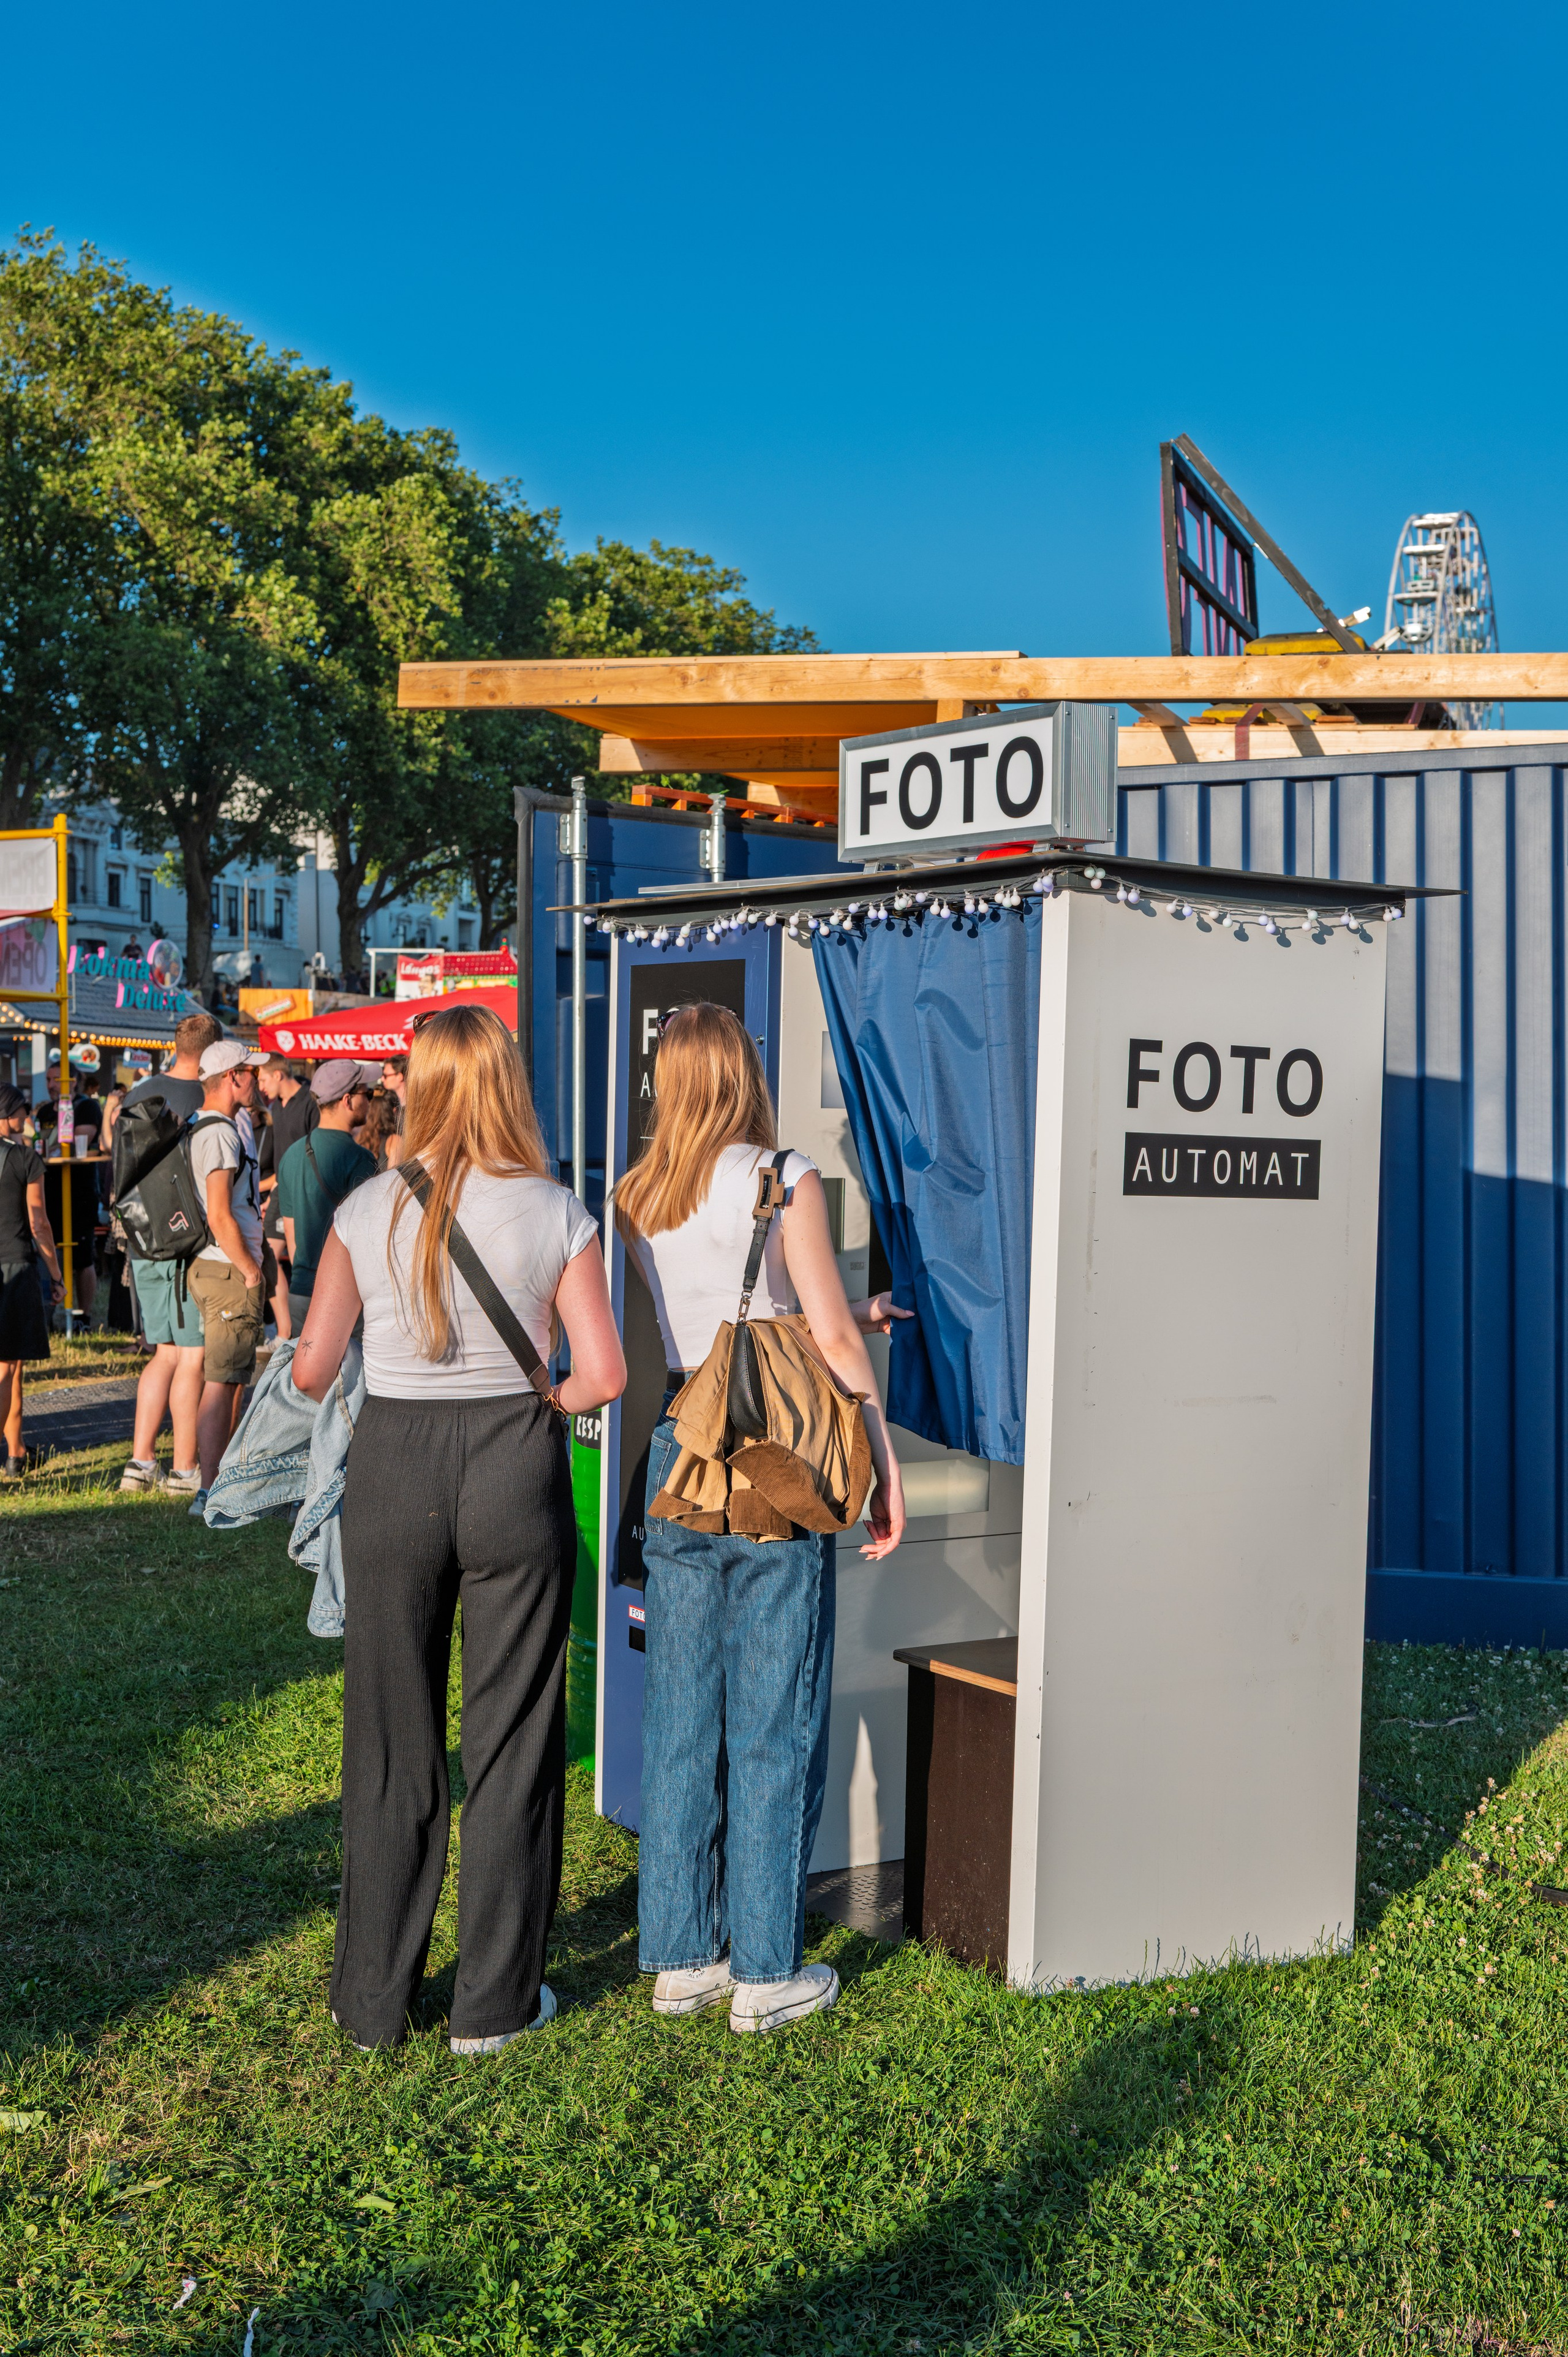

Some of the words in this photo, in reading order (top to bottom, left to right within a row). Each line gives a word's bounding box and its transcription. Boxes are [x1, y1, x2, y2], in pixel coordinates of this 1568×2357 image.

[860, 736, 1044, 836] FOTO
[67, 945, 152, 981] Lokma
[116, 983, 186, 1012] Deluxe
[298, 1034, 409, 1051] HAAKE-BECK
[1127, 1038, 1323, 1117] FOTO
[1132, 1148, 1310, 1186] AUTOMAT
